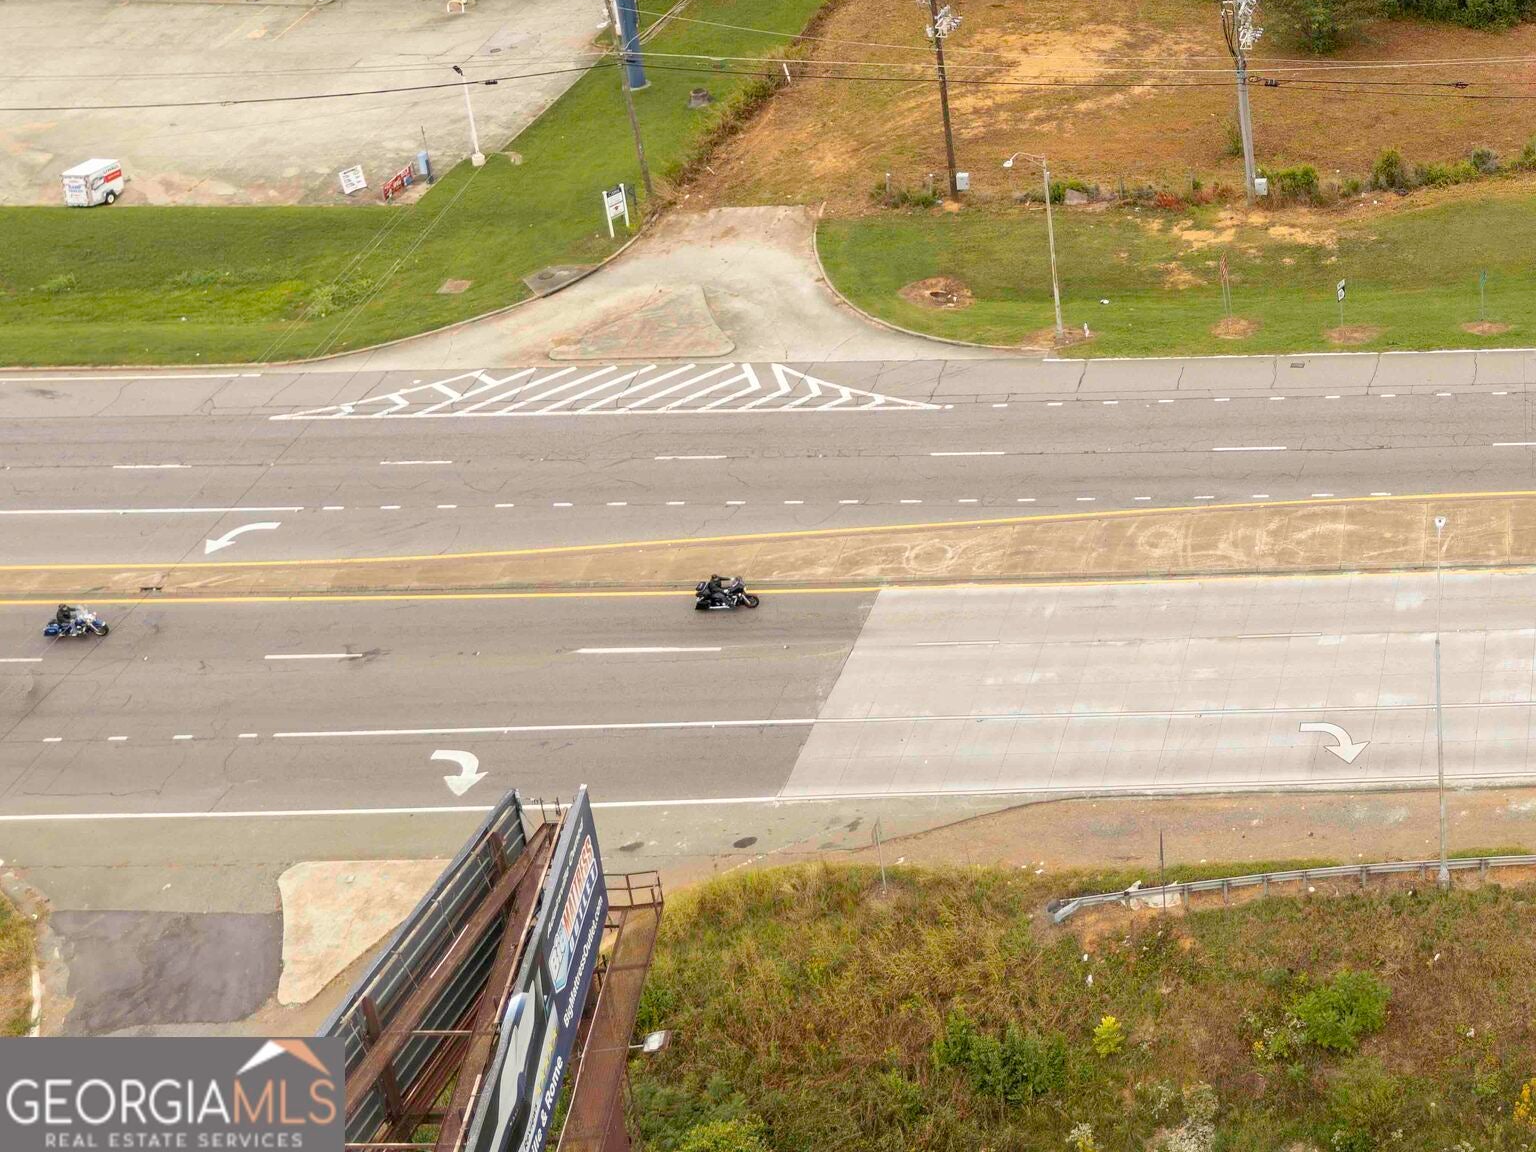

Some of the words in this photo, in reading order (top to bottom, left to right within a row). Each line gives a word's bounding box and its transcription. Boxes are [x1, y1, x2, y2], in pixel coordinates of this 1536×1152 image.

[561, 837, 593, 941] MATTRESS
[569, 865, 596, 953] OUTLET
[548, 925, 567, 982] BIG
[563, 895, 604, 1028] BigMattressOutlet.com
[541, 1108, 548, 1128] &
[544, 1055, 563, 1110] Rome
